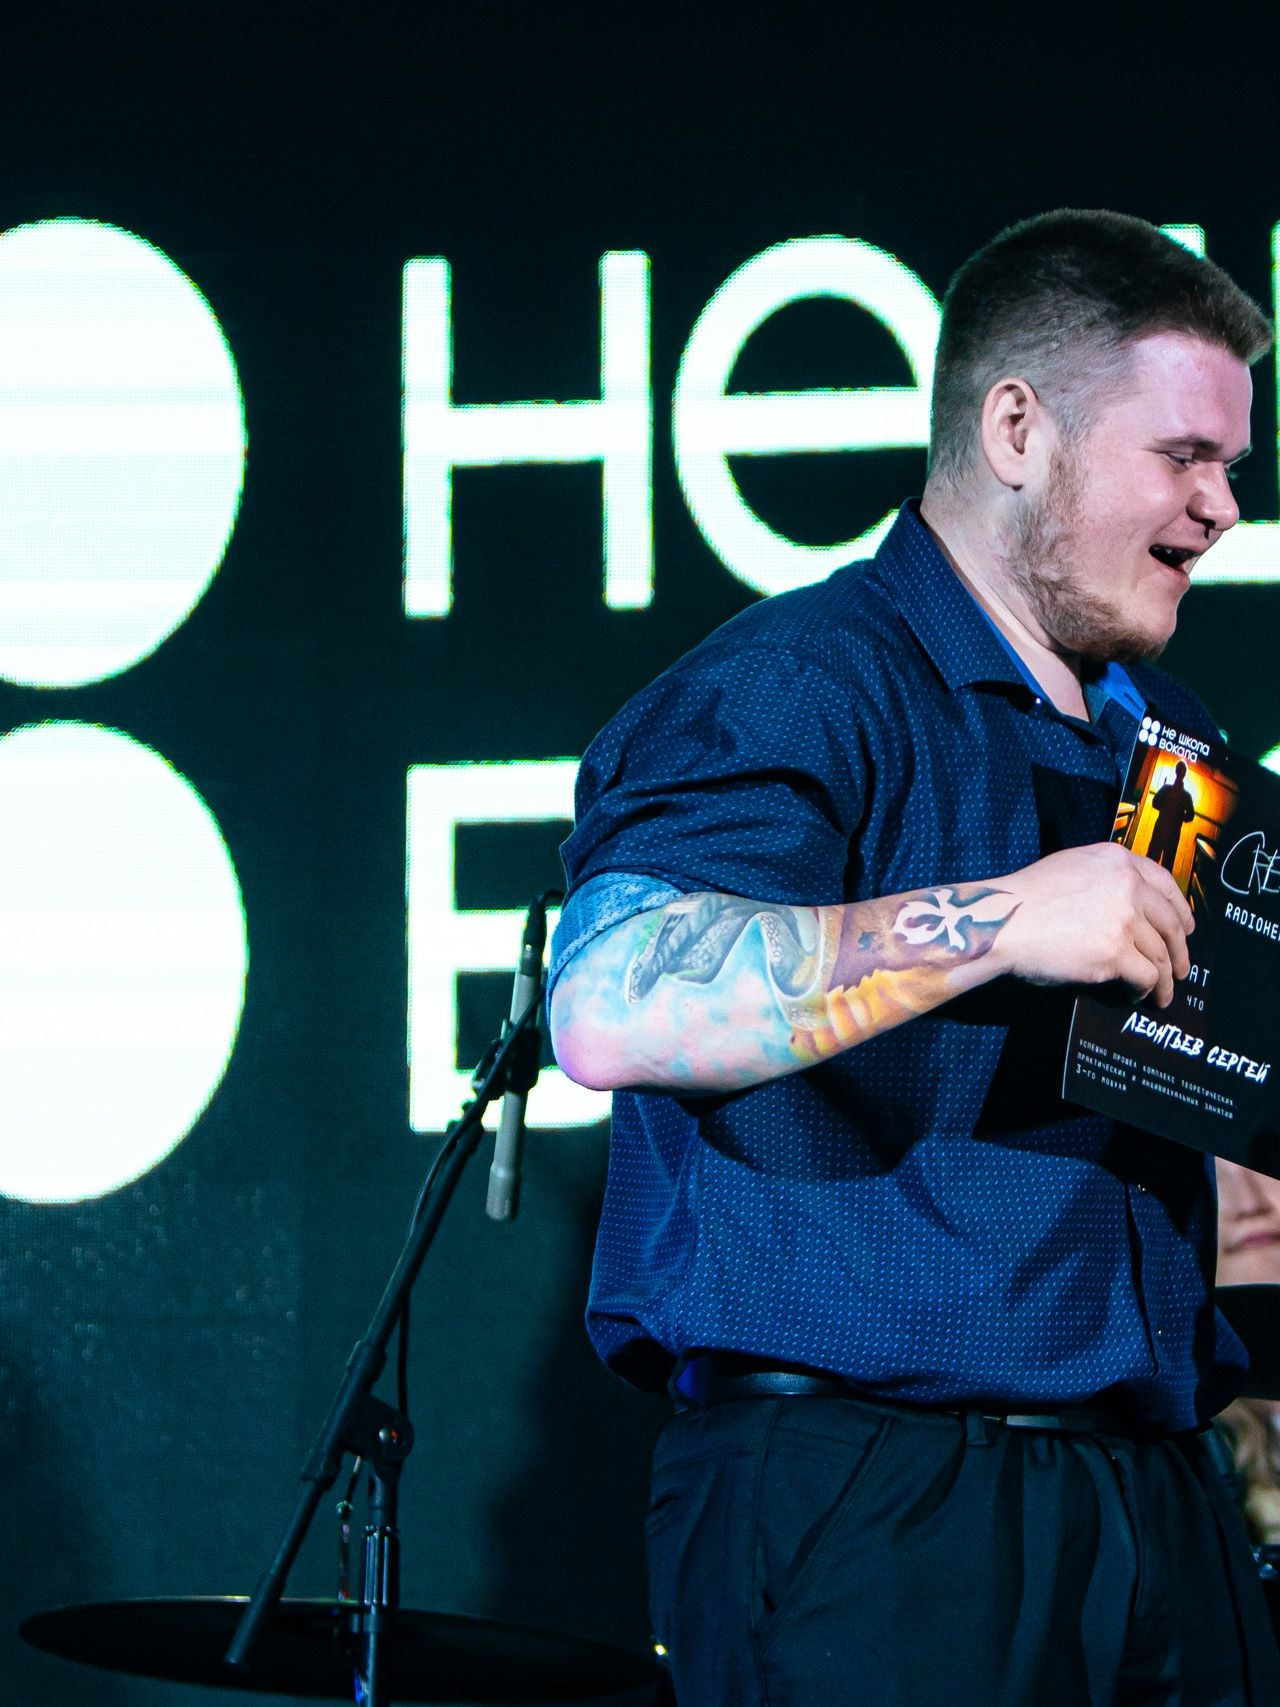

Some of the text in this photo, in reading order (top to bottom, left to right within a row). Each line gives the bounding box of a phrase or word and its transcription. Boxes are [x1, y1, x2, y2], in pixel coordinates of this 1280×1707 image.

[1186, 994, 1205, 1012] ЧТО
[1120, 1010, 1271, 1084] ЛЕОНТЬЕВ СЕРГЕЙ
